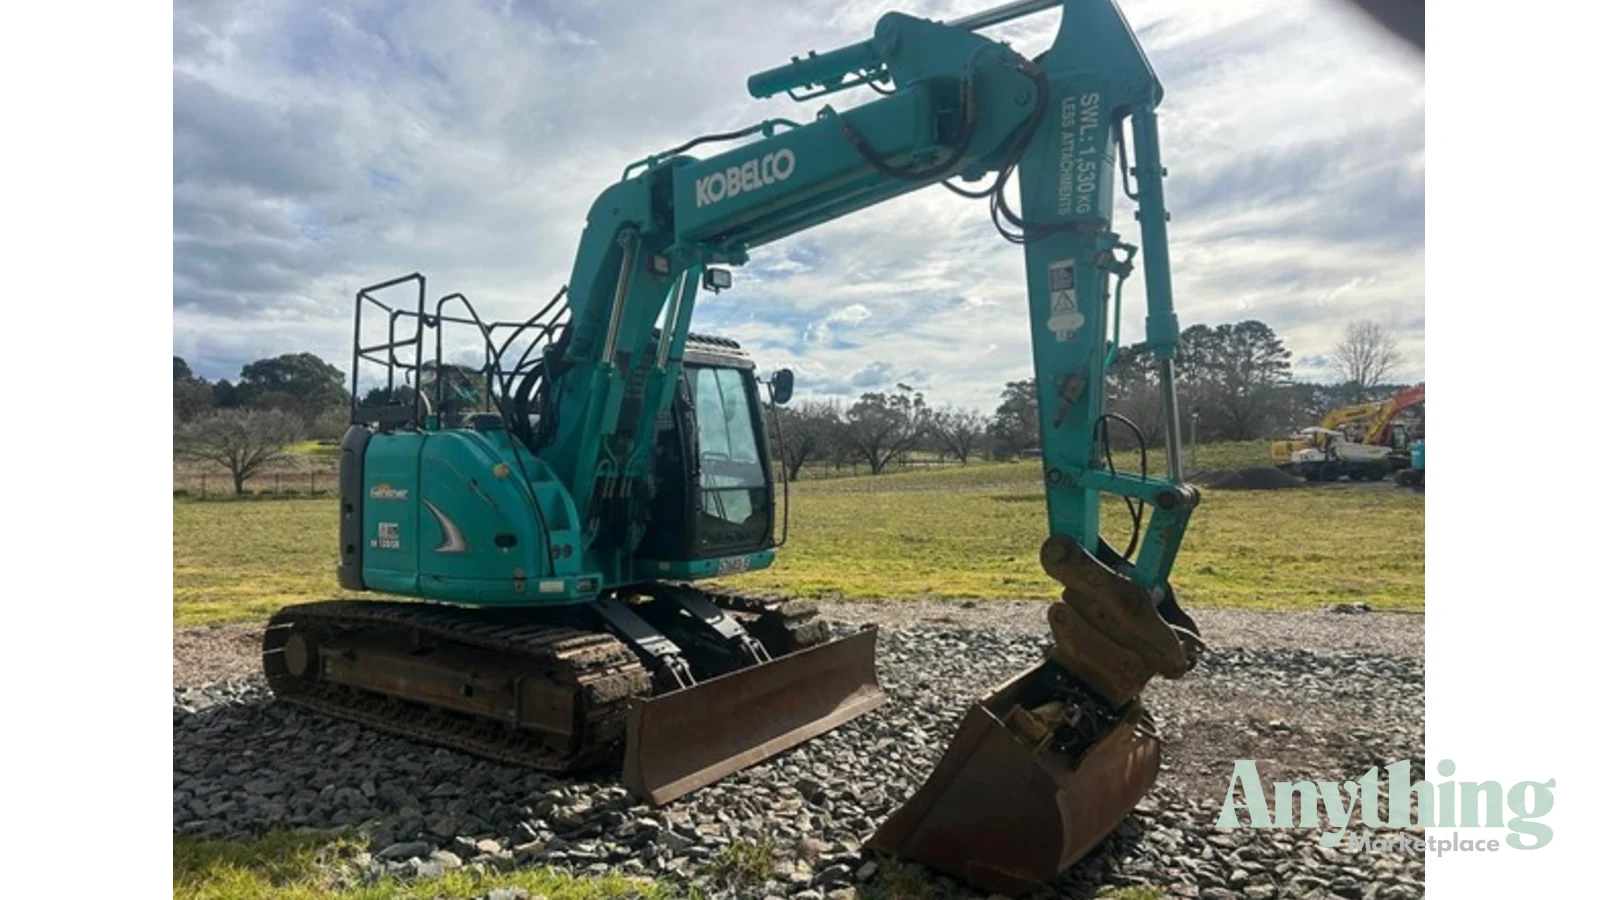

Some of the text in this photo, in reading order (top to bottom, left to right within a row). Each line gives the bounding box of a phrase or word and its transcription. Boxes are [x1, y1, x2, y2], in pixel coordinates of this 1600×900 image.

[696, 148, 795, 208] KOBELCO
[1058, 96, 1075, 216] LESS ATTACHMENTS
